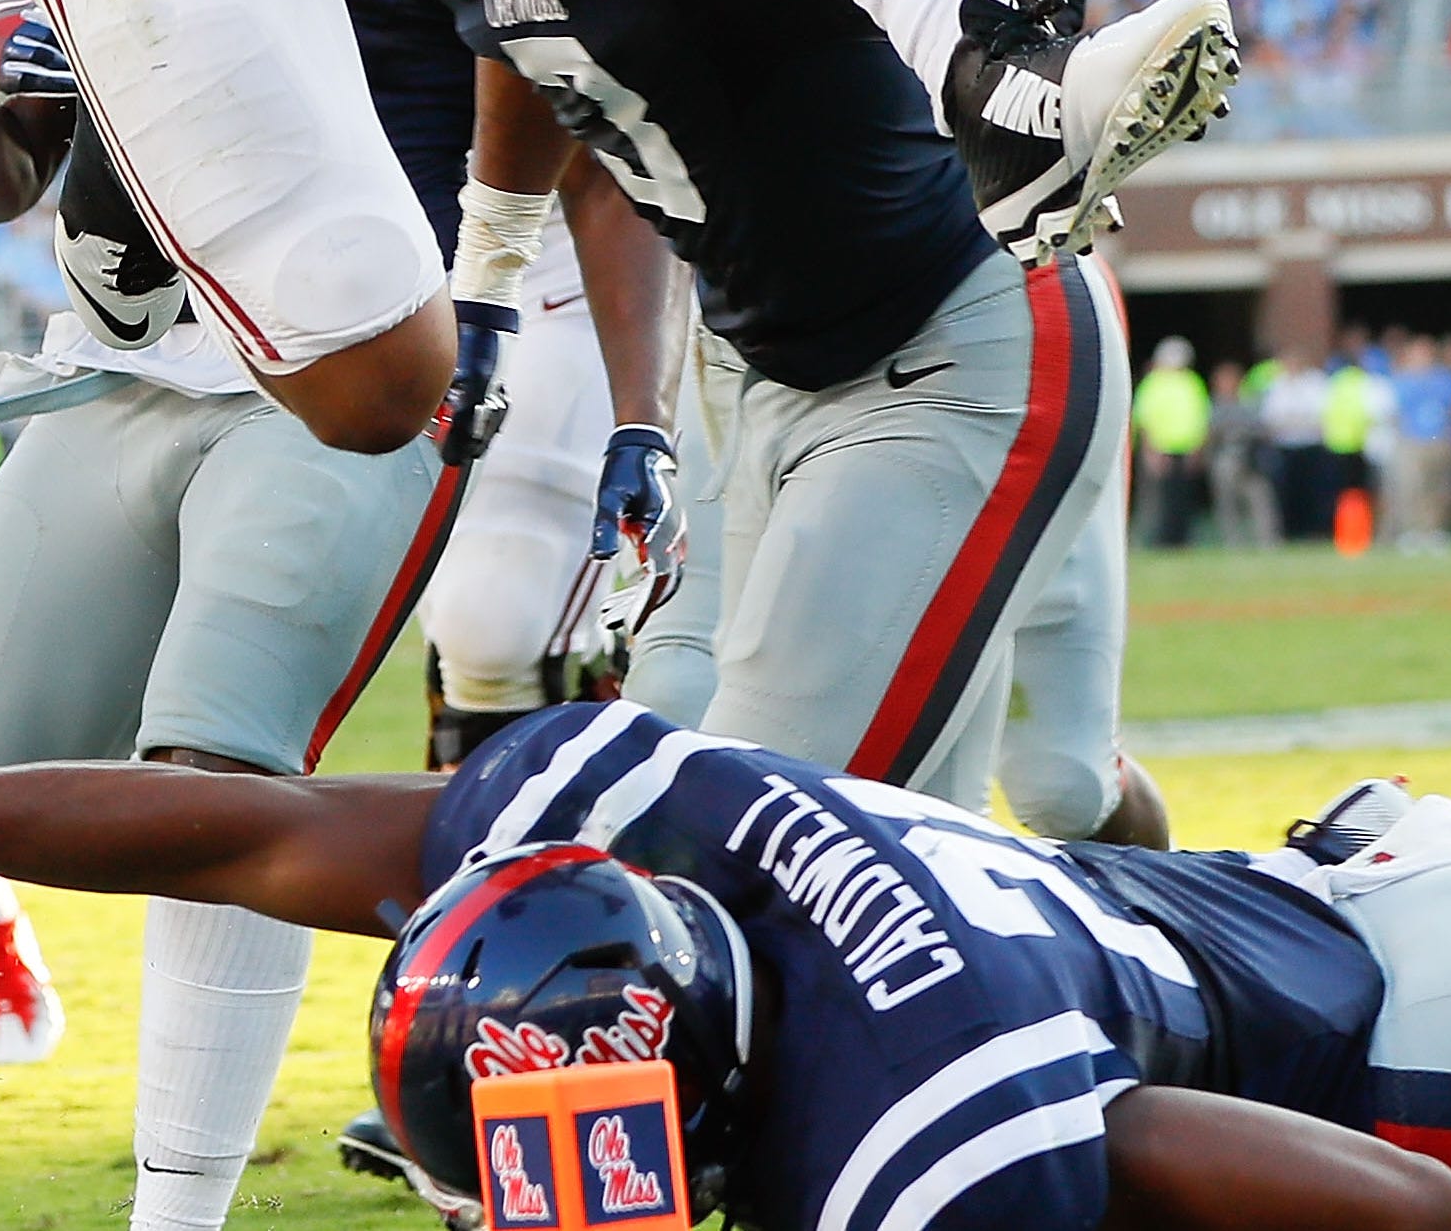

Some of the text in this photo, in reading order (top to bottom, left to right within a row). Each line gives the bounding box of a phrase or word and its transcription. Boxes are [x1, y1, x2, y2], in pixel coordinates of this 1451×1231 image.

[981, 63, 1062, 139] NIKE
[725, 773, 965, 1012] CALDWELL
[491, 1124, 524, 1176] Ole
[588, 1115, 630, 1170] Ole
[499, 1170, 550, 1222] Miss
[599, 1160, 663, 1213] Miss
